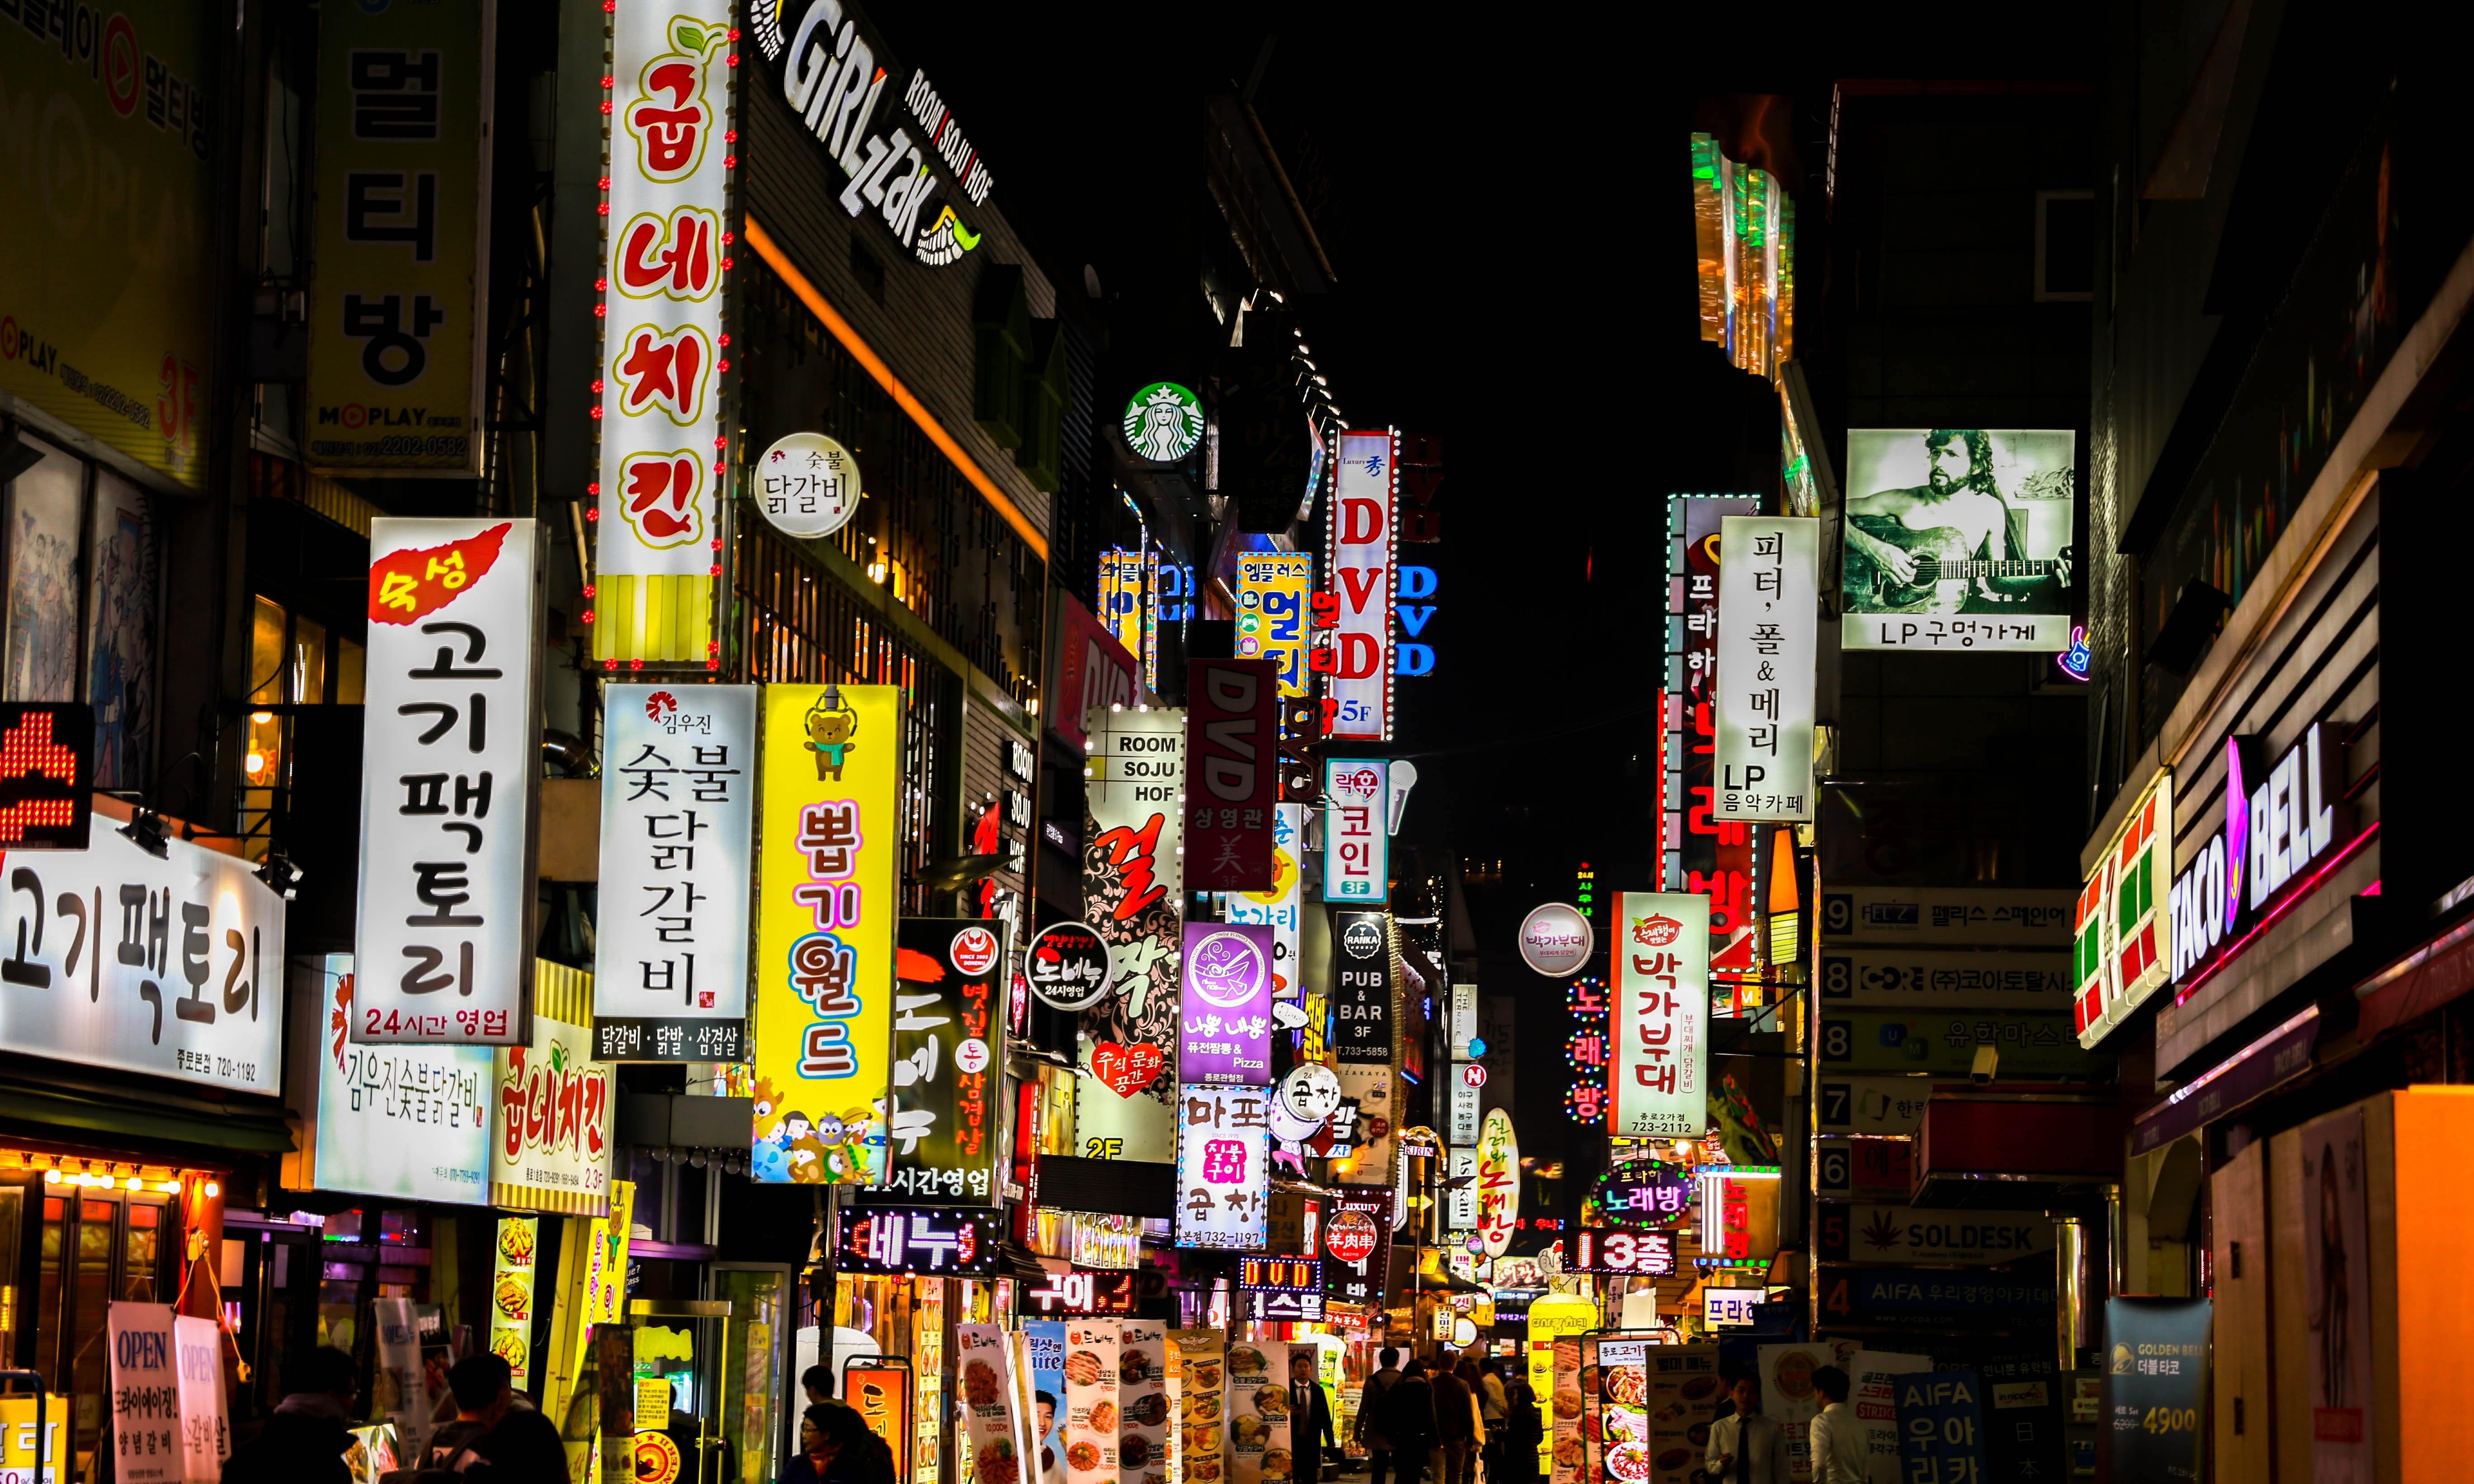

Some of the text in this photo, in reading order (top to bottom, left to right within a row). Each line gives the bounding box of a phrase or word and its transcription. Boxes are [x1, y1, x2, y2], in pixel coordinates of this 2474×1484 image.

[145, 52, 213, 162] 멀티방
[905, 68, 994, 207] ROOM SOJU HOF
[344, 51, 443, 386] 멀티방
[623, 62, 710, 538] 굽네치킨
[157, 351, 199, 452] 3F
[805, 450, 845, 470] 숯불
[1343, 457, 1366, 467] Luxury
[764, 473, 847, 515] 닭갈비
[379, 550, 466, 612] 숙성
[1244, 562, 1307, 583] 엠플러스
[1337, 497, 1384, 680] DVD
[1395, 565, 1439, 676] DVD
[1688, 575, 1717, 678] 프라하
[1881, 620, 2035, 648] LP 구멍가게
[661, 714, 712, 736] 김우진
[1341, 700, 1372, 722] 5F
[1120, 736, 1176, 753] ROOM
[1205, 666, 1258, 803] DVD
[619, 744, 741, 803] 숯불
[1012, 740, 1033, 783] ROOM
[1124, 762, 1175, 777] SOJU
[1724, 764, 1765, 791] LP
[397, 621, 503, 996] 고기팩토리
[1135, 787, 1174, 802] HOF
[1723, 794, 1803, 814] 음악카페
[1011, 790, 1031, 829] SOJU
[1194, 808, 1264, 830] 상영관
[1211, 834, 1245, 874] 美
[1339, 806, 1371, 876] 코인
[2167, 722, 2333, 985] TACO BELL
[1009, 839, 1025, 874] HOF
[1345, 882, 1366, 893] 3F
[638, 809, 708, 1006] 닭갈비
[1827, 899, 2065, 930] 9 펠리스 스페인어
[791, 802, 860, 1076] 뽑기월드
[1347, 936, 1378, 944] RANKA
[1526, 934, 1586, 947] 박가부대
[1045, 985, 1085, 997] 24시영업
[1342, 972, 1382, 987] PUB
[1826, 962, 1849, 993] 8
[1357, 990, 1366, 1001] &
[365, 1008, 508, 1036] 24시간 영업
[1340, 1005, 1382, 1020] BAR
[1633, 952, 1682, 1095] 박가부대
[602, 1026, 738, 1057] 닭갈비 닭발 삼겹살
[1355, 1027, 1371, 1037] 3F
[1826, 1025, 1849, 1056] 8
[1187, 1041, 1242, 1055] 퓨전짬뽕 &
[1337, 1046, 1388, 1056] T.733-5858
[1574, 986, 1603, 1117] 노래방
[176, 1048, 255, 1082] 종로본점 720-1192
[1096, 1051, 1161, 1080] 주식 문화
[1233, 1057, 1264, 1069] Pizza
[1114, 1069, 1147, 1093] 공간
[1204, 1072, 1244, 1083] 종로관철점
[501, 1046, 606, 1157] 굽네치킨
[1292, 1080, 1338, 1107] 곱창
[1187, 1096, 1267, 1129] 마포
[1639, 1112, 1686, 1122] 종로2가점
[1631, 1121, 1692, 1133] 723-2112
[1086, 1137, 1123, 1159] 2F
[1405, 1145, 1434, 1157] KIRIN
[1207, 1162, 1241, 1181] 구이
[1621, 1170, 1662, 1184] 프라하
[1186, 1187, 1261, 1223] 곱창
[1336, 1200, 1380, 1214] Luxury
[1606, 1186, 1682, 1212] 노래방
[1723, 1177, 1752, 1259] 노래방
[1182, 1231, 1259, 1244] 본점 732-1197
[1328, 1233, 1374, 1249] 羊肉串
[1824, 1216, 2033, 1250] 5 SOLDESK
[1603, 1234, 1671, 1272] 3층
[1245, 1261, 1308, 1287] DVD
[1029, 1273, 1093, 1310] 구이
[1826, 1278, 1852, 1316] 4
[1870, 1282, 1924, 1301] AIFA
[117, 1330, 167, 1370] OPEN
[181, 1343, 216, 1383] OPEN
[1601, 1347, 1618, 1357] 종로
[2138, 1343, 2205, 1356] GOLDEN BELL
[2138, 1359, 2180, 1376] 더블타코
[1902, 1381, 1974, 1408] AIFA
[2142, 1406, 2195, 1435] 4900
